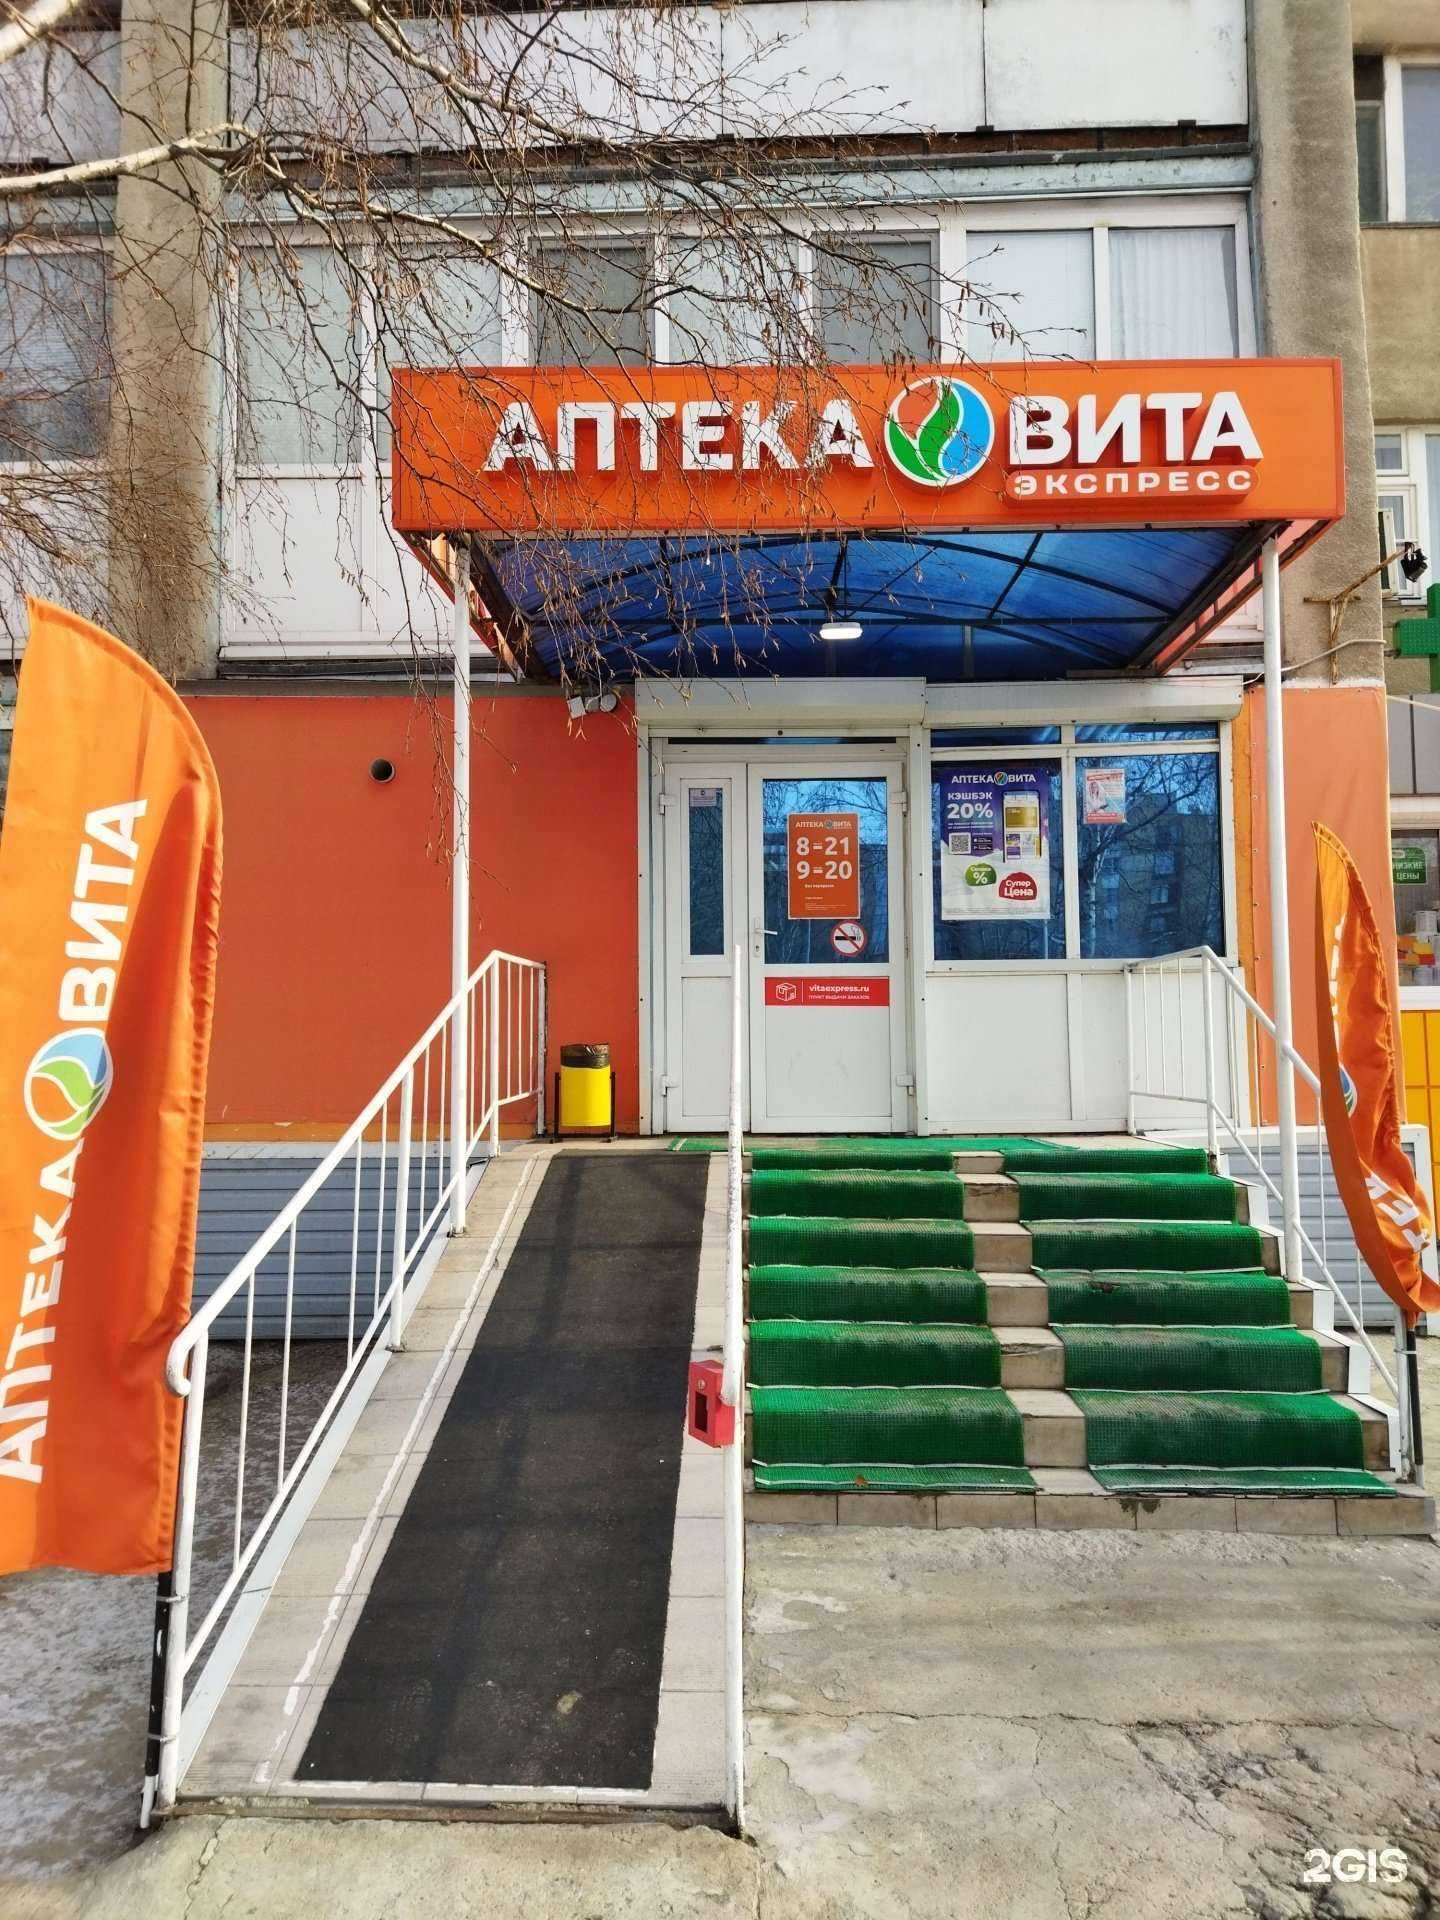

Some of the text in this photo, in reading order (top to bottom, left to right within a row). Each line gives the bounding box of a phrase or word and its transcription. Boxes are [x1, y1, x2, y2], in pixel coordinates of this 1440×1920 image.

[483, 392, 1264, 471] АПТЕКА ВИТА
[1013, 470, 1251, 496] ЭКСПРЕСС
[951, 774, 1037, 784] АПТЕКА ВИТА
[947, 792, 993, 800] КЭШБЭК
[946, 803, 994, 819] 20%
[1396, 872, 1420, 881] ЦЕНЫ
[1005, 880, 1032, 889] Супер
[1004, 887, 1034, 897] Цена
[809, 984, 870, 993] vitaexpress.ru
[0, 799, 148, 1484] АПТЕКА ВИТА
